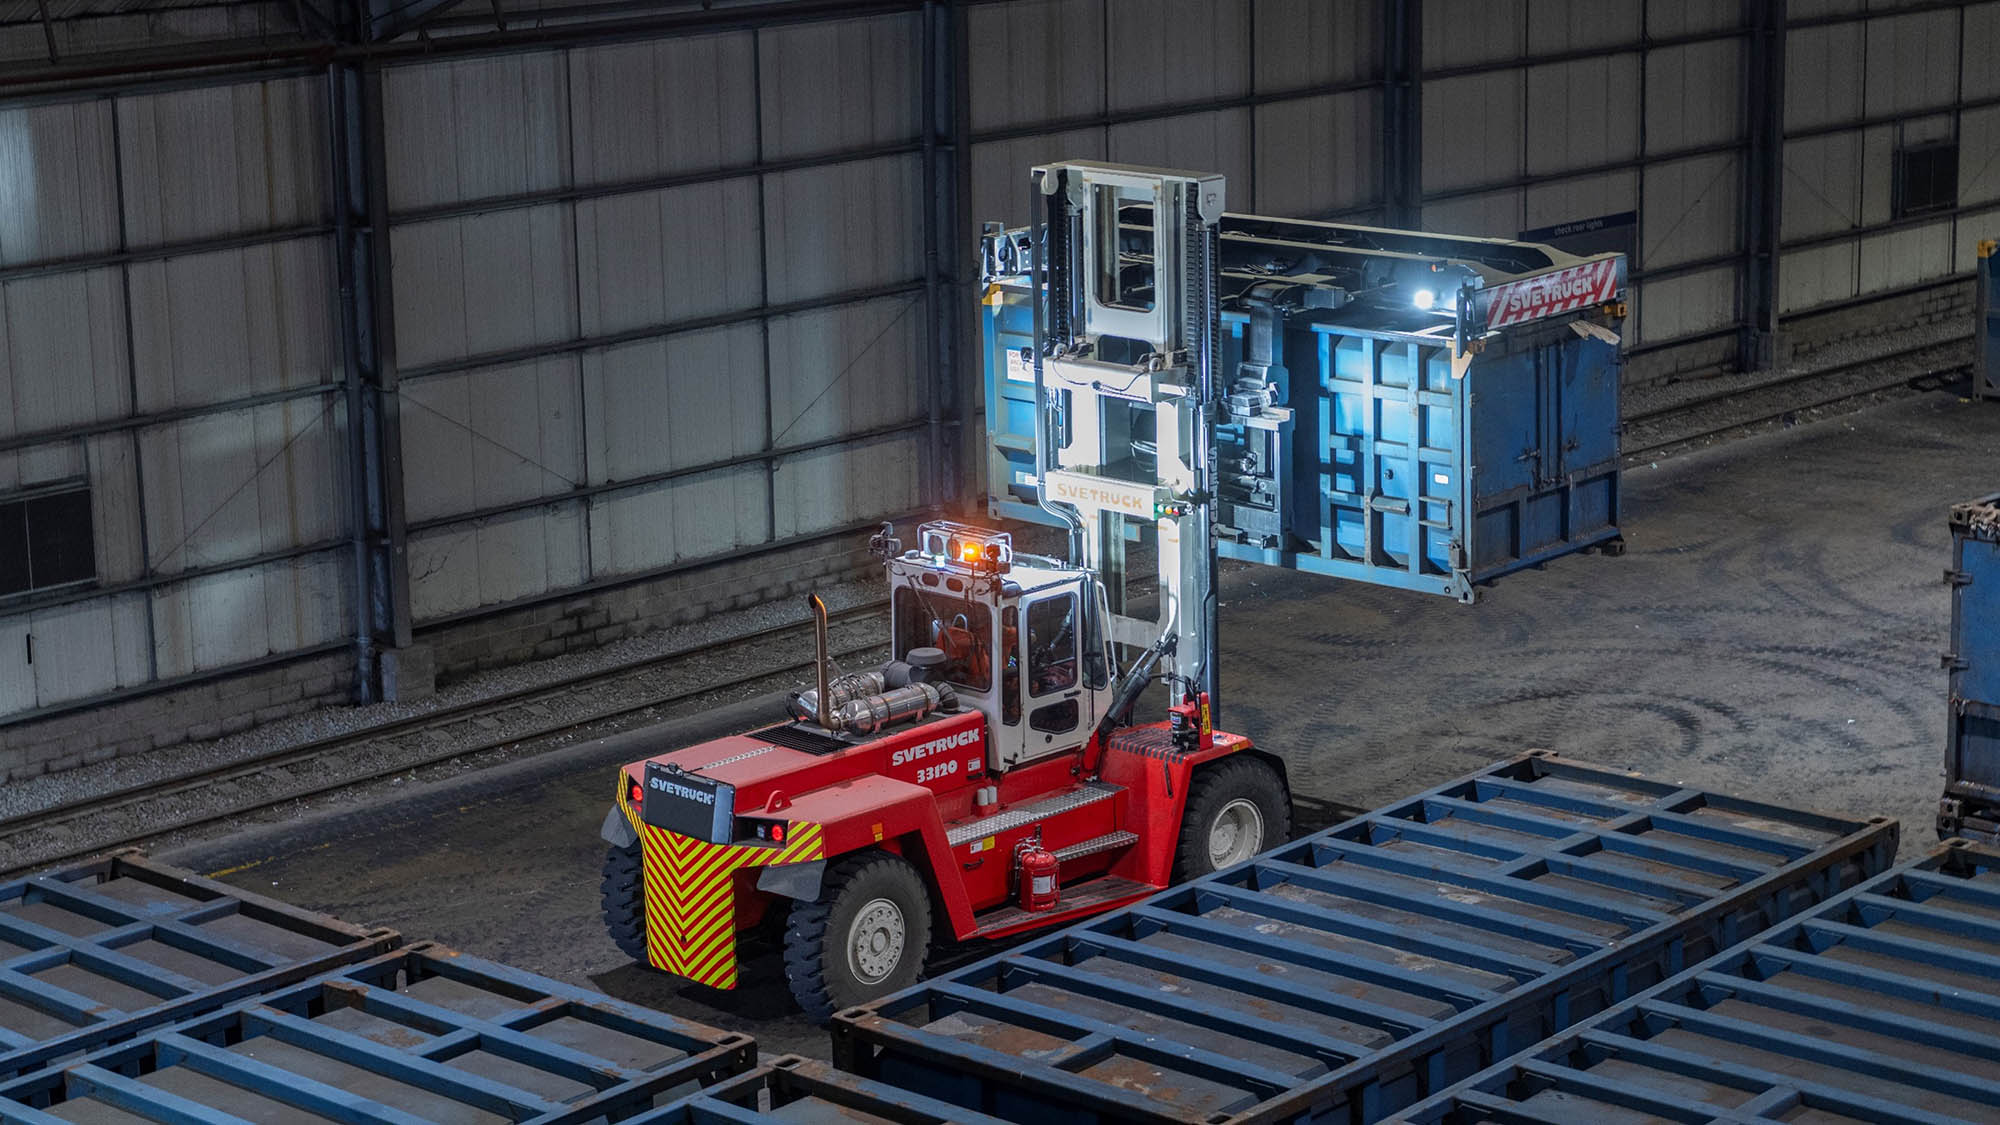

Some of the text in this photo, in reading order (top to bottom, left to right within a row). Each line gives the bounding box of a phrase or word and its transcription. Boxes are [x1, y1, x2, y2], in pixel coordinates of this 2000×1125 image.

[1510, 276, 1593, 312] SVETRUCK
[1056, 482, 1143, 509] SVETRUCK
[892, 727, 980, 767] SVETRUCK
[916, 759, 958, 784] 33120
[650, 776, 714, 805] SVETRUCK
